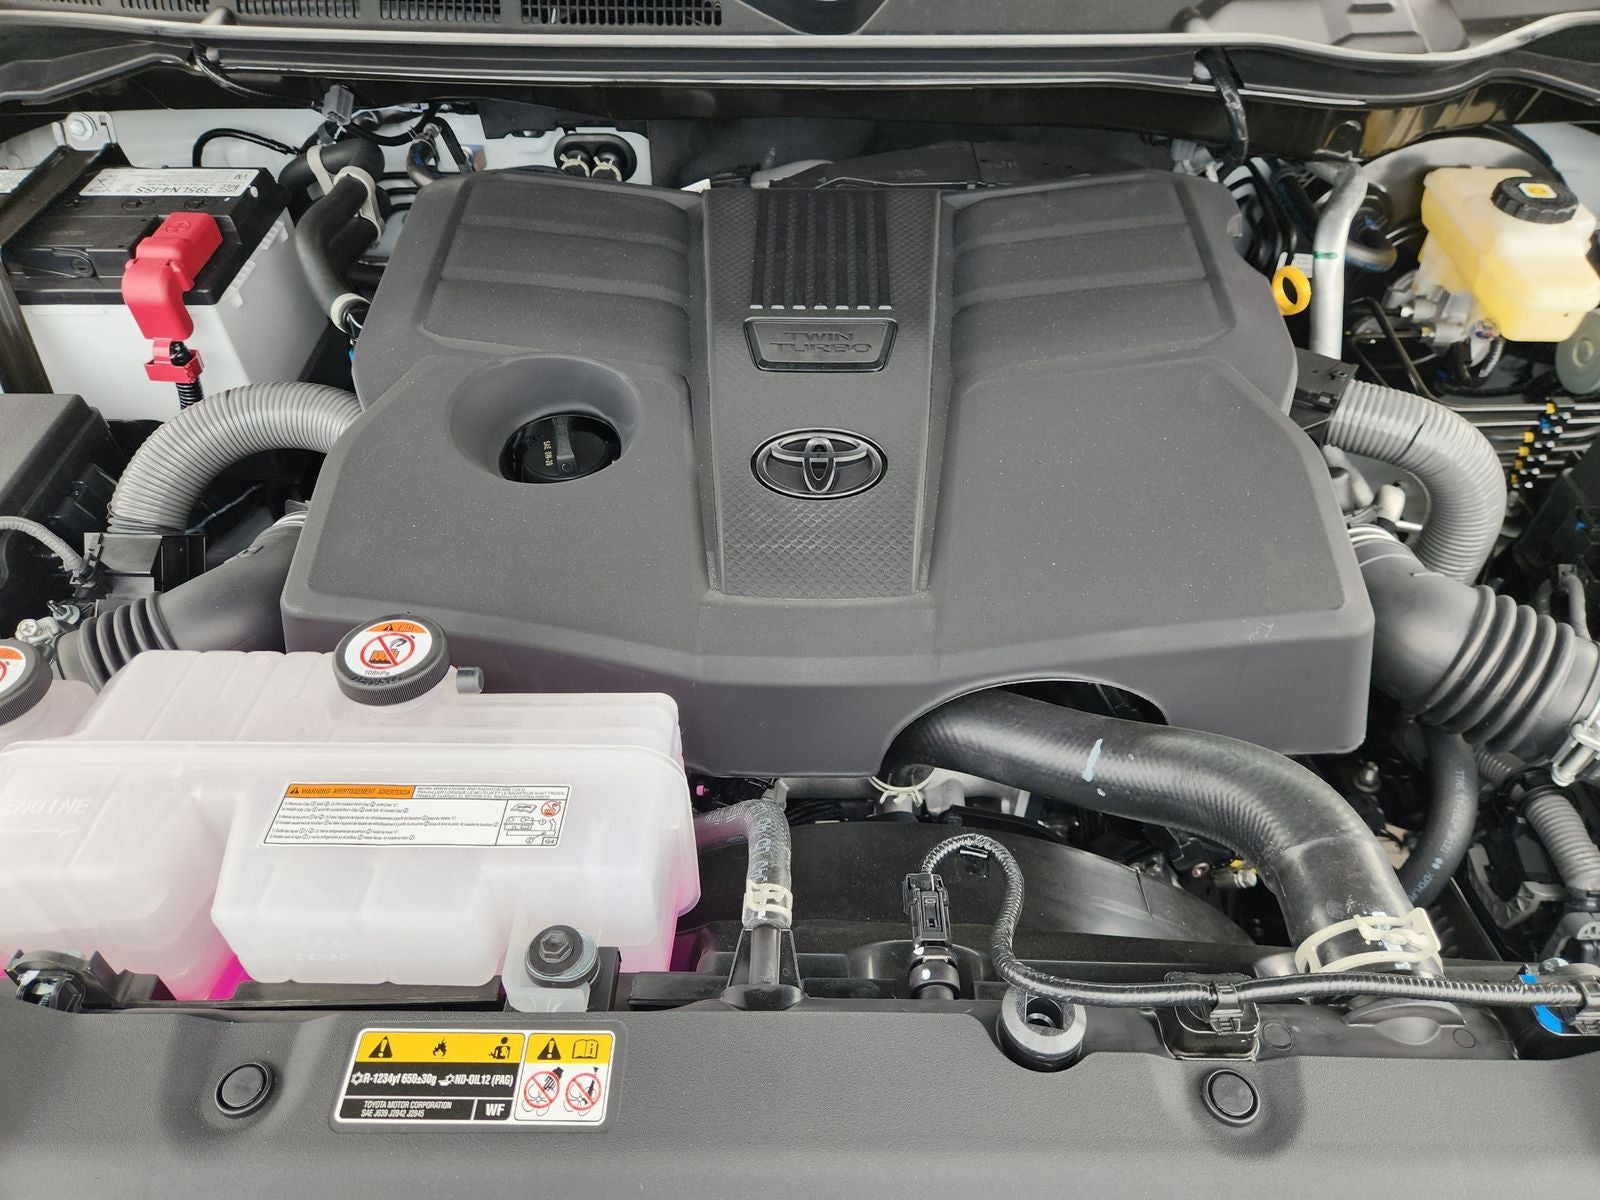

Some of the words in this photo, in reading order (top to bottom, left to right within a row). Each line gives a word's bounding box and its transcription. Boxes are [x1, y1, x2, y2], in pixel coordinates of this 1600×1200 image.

[782, 332, 854, 341] TWIN
[769, 342, 873, 353] TURBO
[363, 1072, 401, 1086] R-1234yf
[401, 1073, 437, 1086] 650±30g
[455, 1074, 490, 1086] ND-OIL12
[491, 1074, 514, 1086] (PAG)
[364, 1101, 388, 1109] TOYOTA
[387, 1101, 410, 1109] MOTOR
[410, 1101, 452, 1110] CORPORATION
[485, 1103, 506, 1116] WF
[361, 1109, 373, 1118] SAE
[373, 1109, 388, 1118] J639
[388, 1110, 406, 1118] J2842
